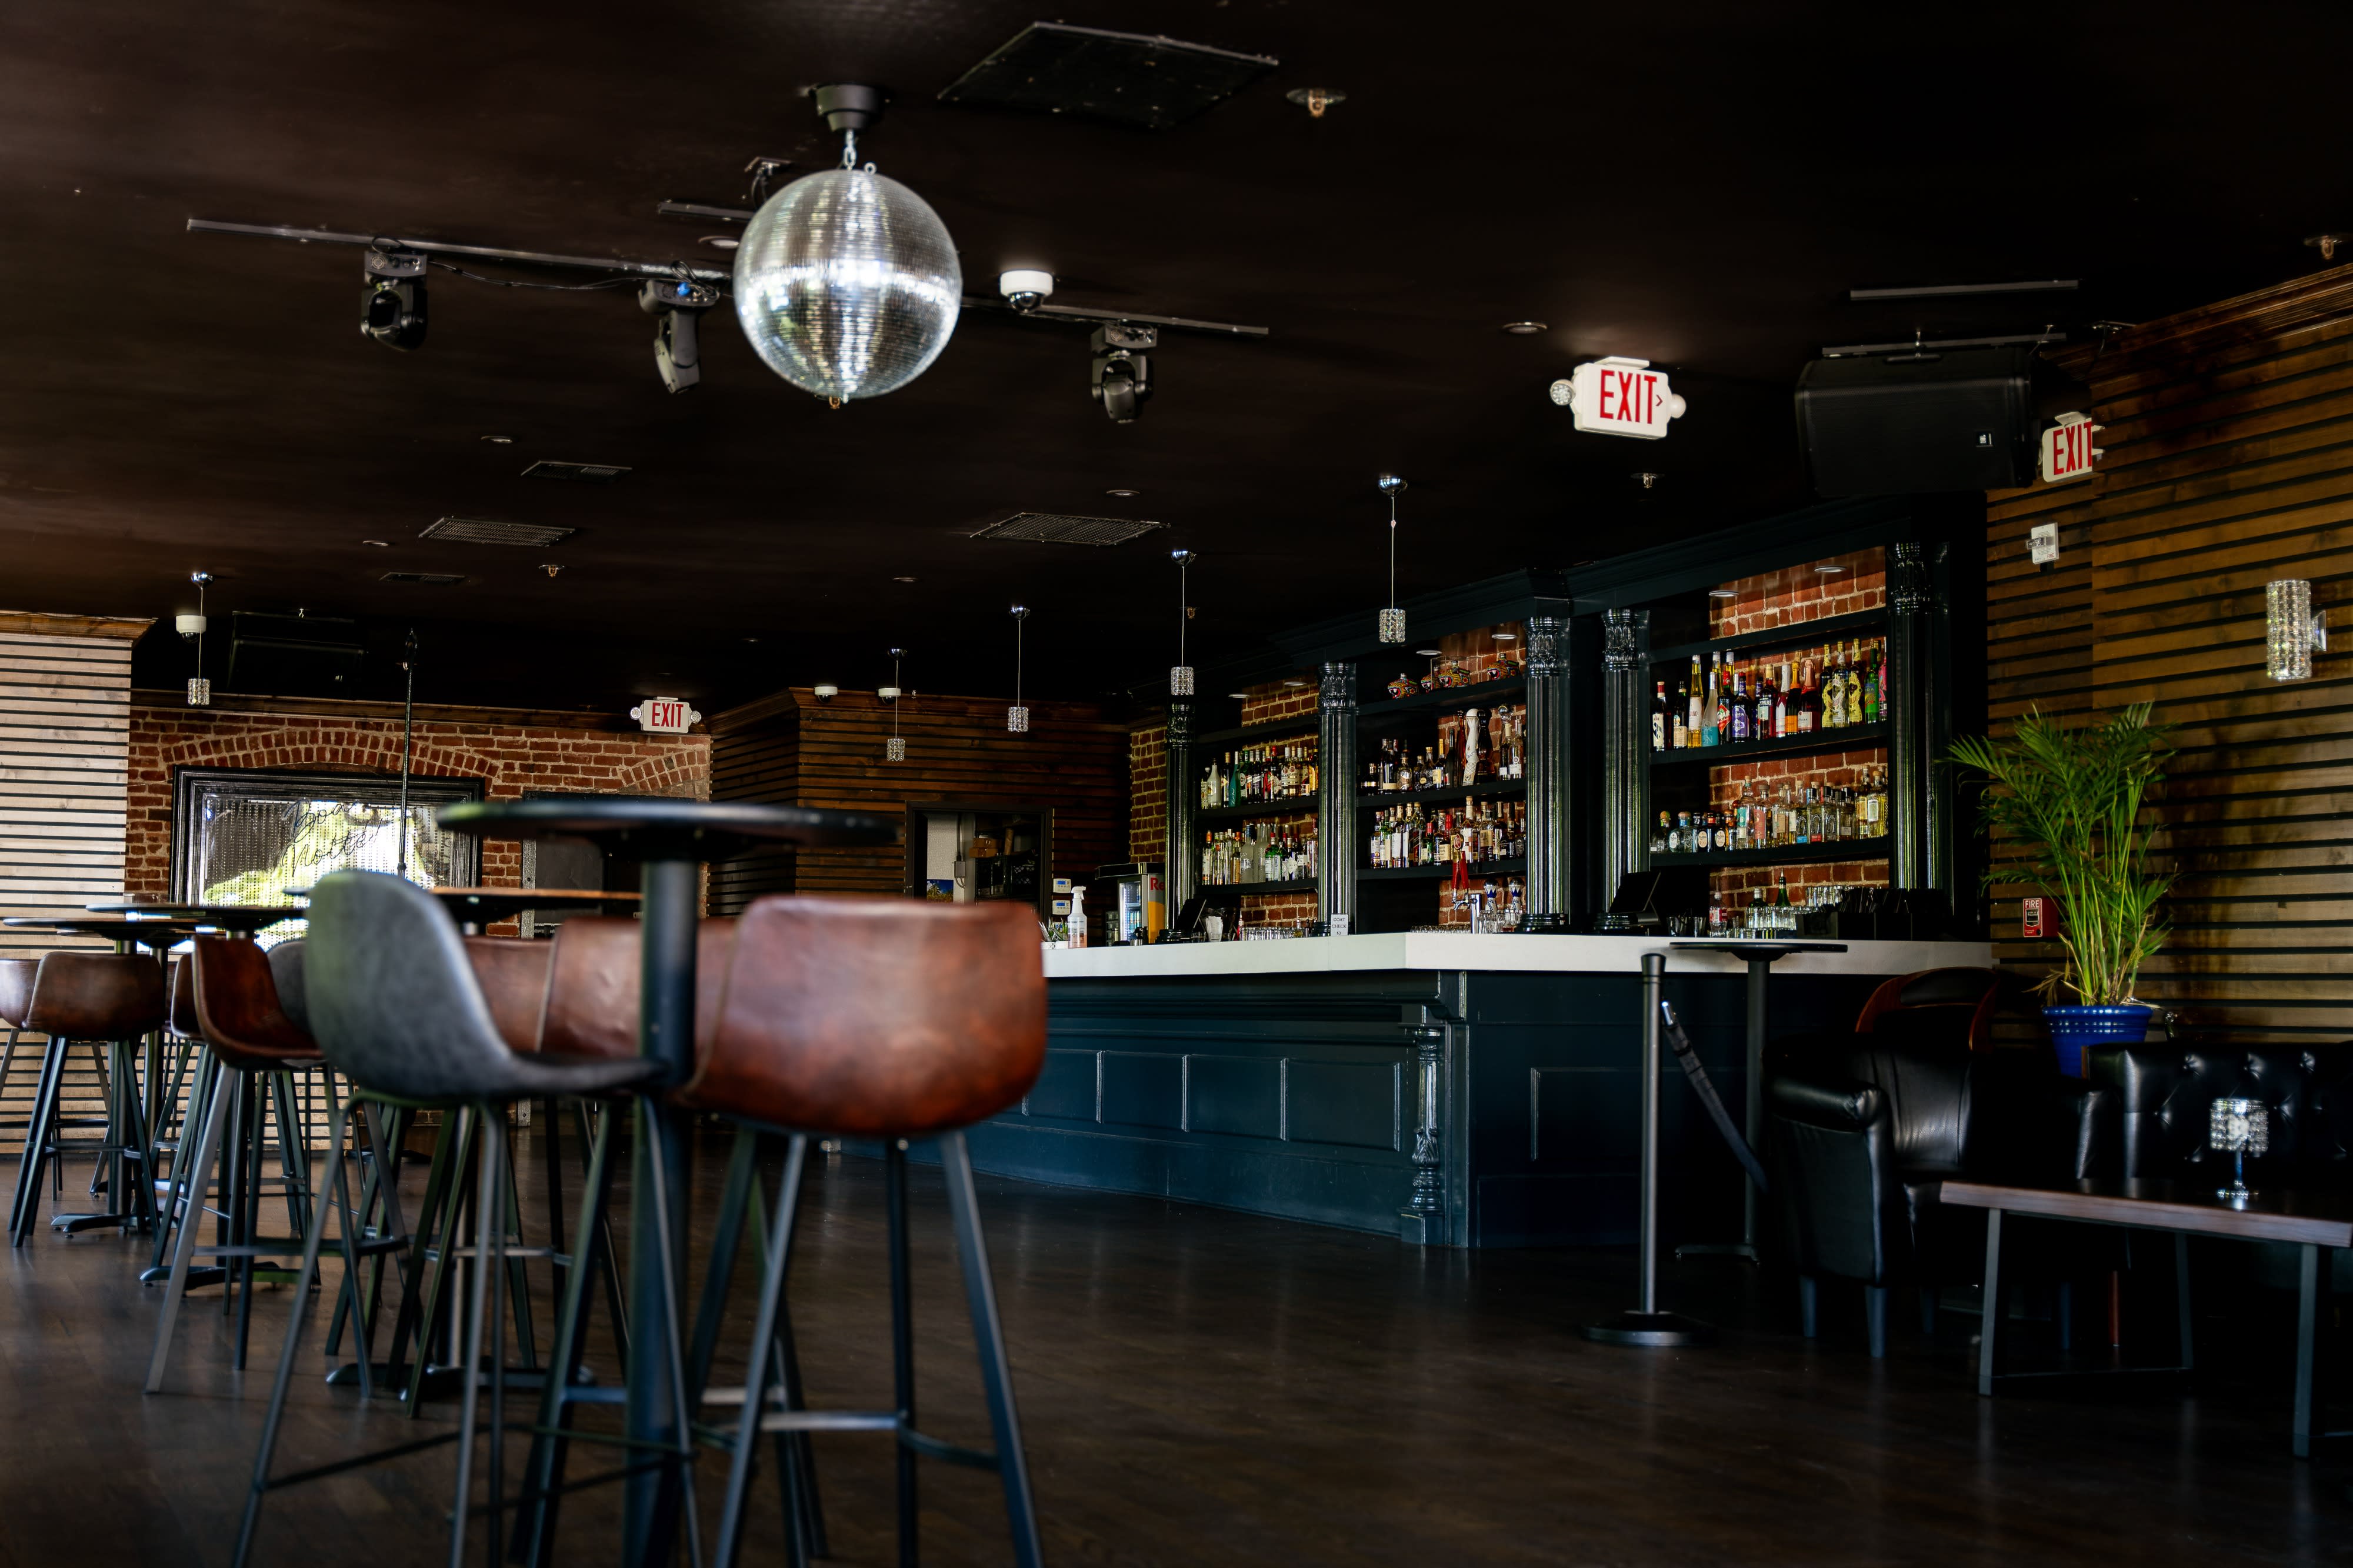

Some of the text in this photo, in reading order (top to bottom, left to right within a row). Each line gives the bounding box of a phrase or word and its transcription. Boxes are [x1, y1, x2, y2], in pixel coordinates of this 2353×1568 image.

[1599, 369, 1657, 424] EXIT
[2053, 421, 2092, 475] EXIT
[651, 702, 684, 728] EXIT
[284, 799, 359, 843] Boa
[1151, 878, 1165, 890] Re
[2025, 900, 2039, 909] FIRE
